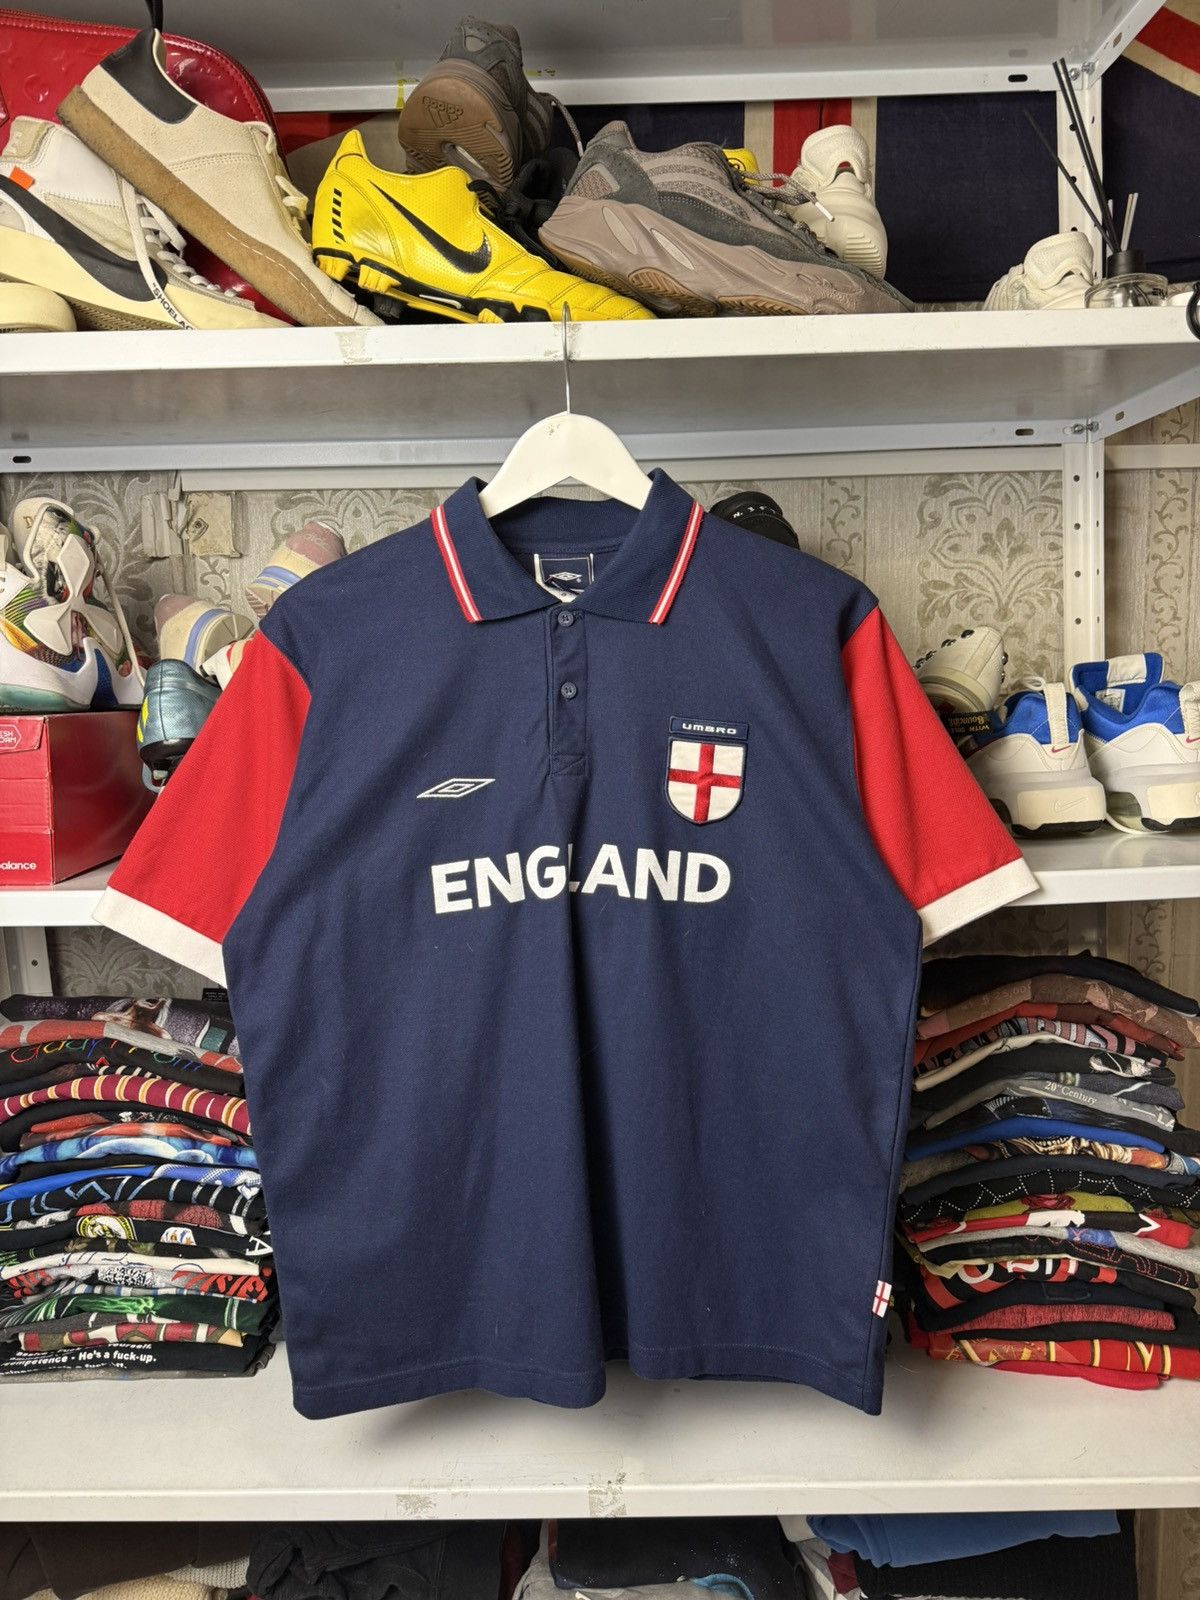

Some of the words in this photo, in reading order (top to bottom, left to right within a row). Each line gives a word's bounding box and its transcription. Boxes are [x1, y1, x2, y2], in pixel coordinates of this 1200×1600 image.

[682, 722, 737, 735] UMBRO
[0, 861, 37, 870] alance
[431, 843, 731, 914] ENGLAND
[1061, 1086, 1098, 1106] Century
[78, 1350, 102, 1361] He's
[103, 1351, 110, 1359] a
[113, 1350, 157, 1364] fuck-up.
